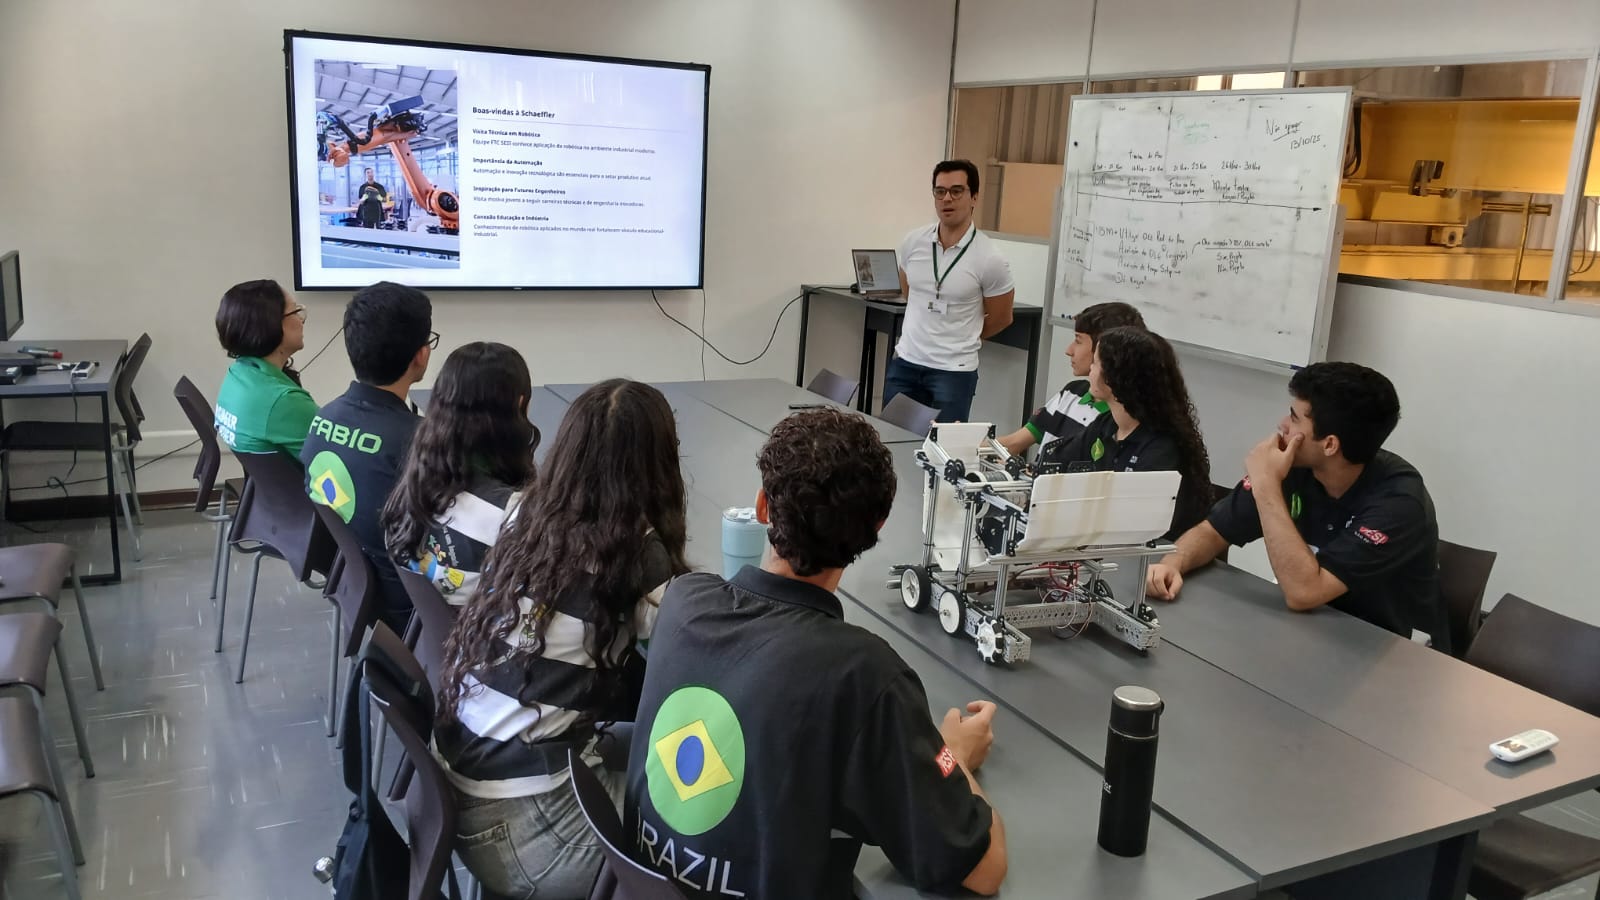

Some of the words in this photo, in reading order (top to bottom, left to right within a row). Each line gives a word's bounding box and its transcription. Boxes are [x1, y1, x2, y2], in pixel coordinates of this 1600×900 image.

[472, 107, 514, 116] Boas-vindas
[521, 110, 555, 118] Schaeffler
[1290, 134, 1320, 150] 13/10/25
